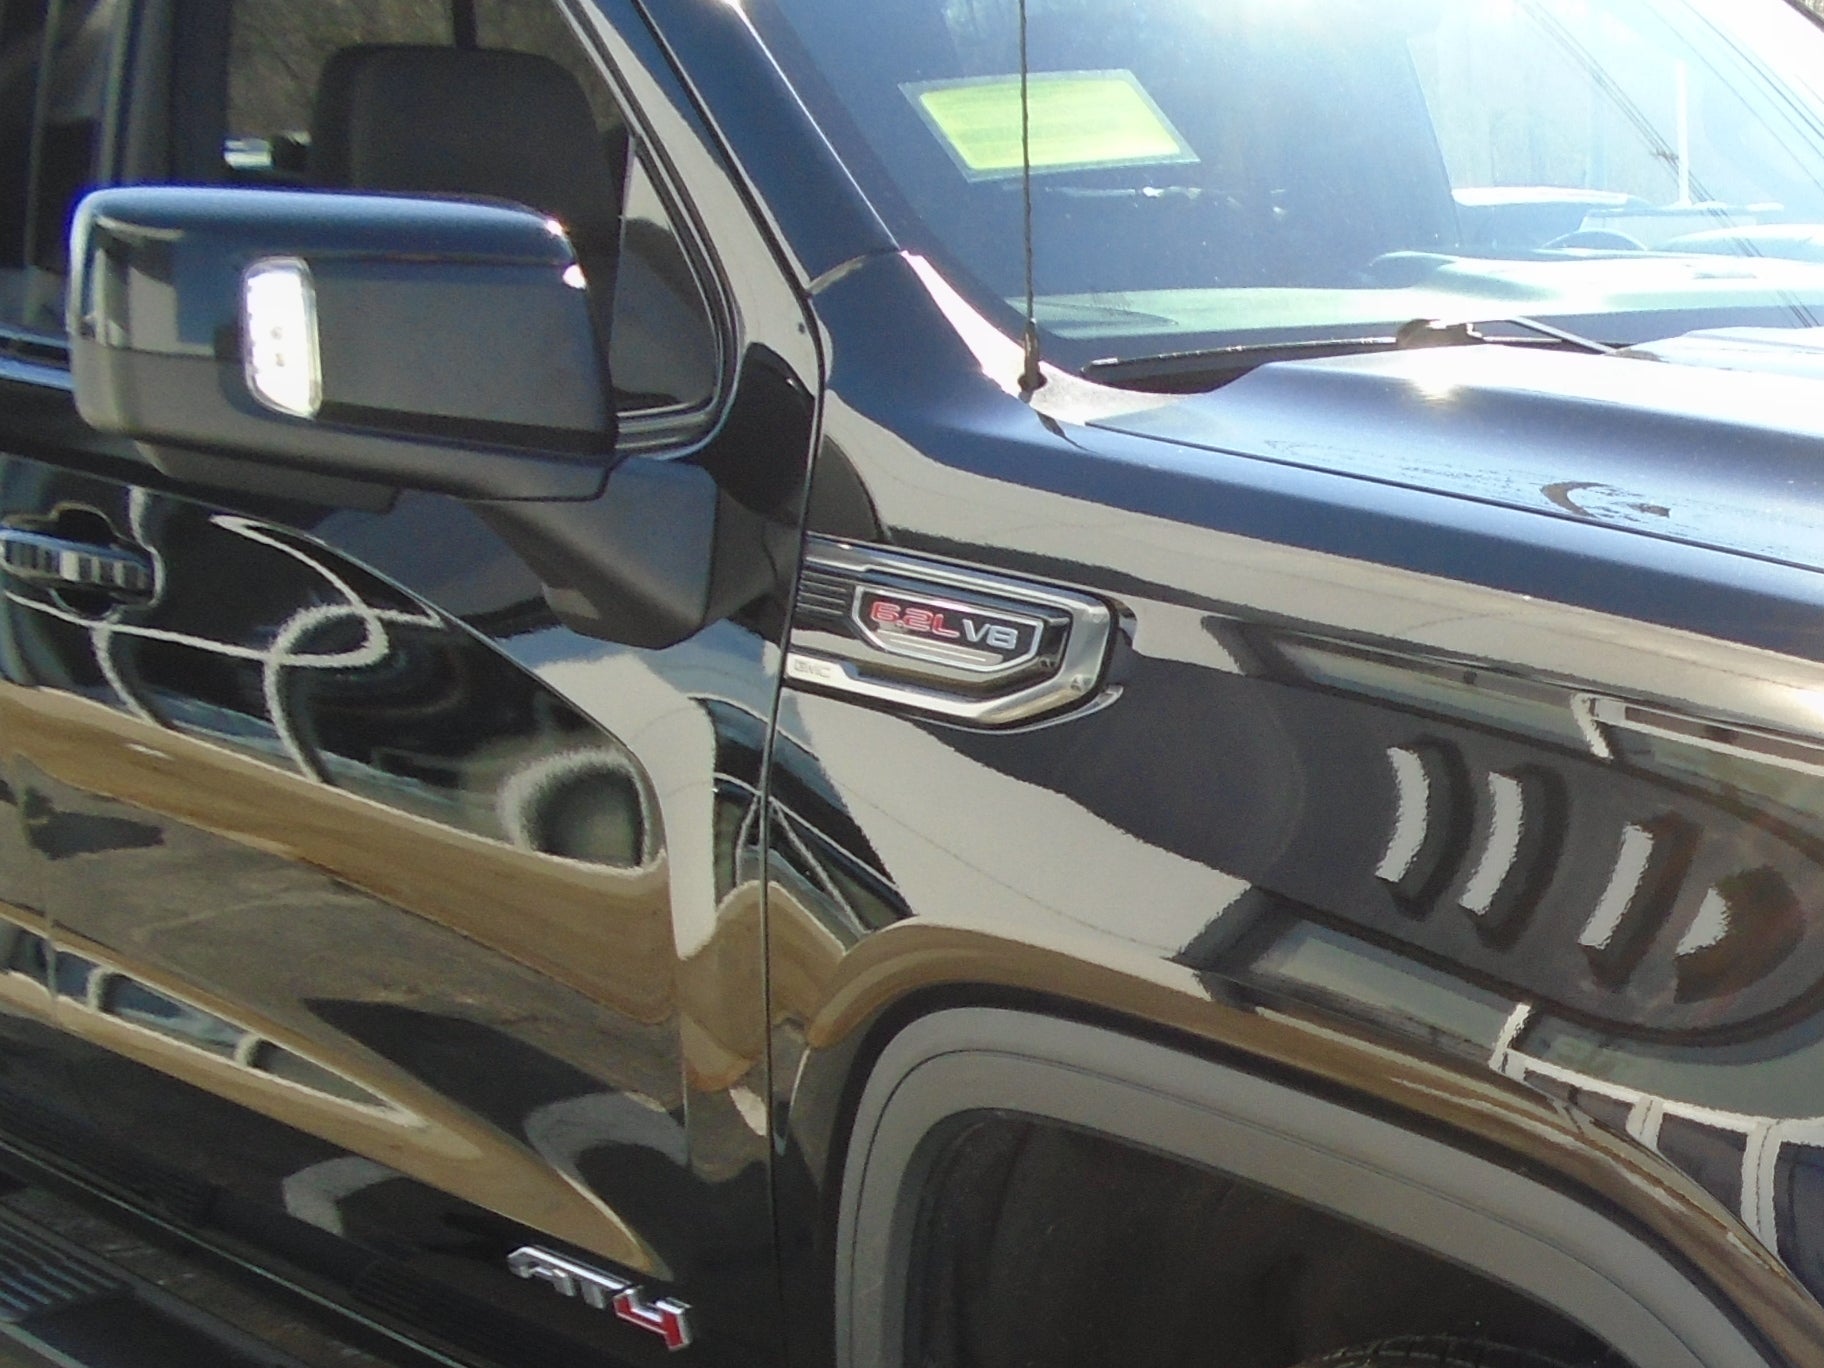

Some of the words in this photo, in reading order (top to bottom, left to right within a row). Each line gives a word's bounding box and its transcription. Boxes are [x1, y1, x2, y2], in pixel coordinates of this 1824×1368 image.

[871, 601, 960, 638] 6.2L
[962, 617, 1018, 651] V8
[507, 1245, 693, 1351] AT4
